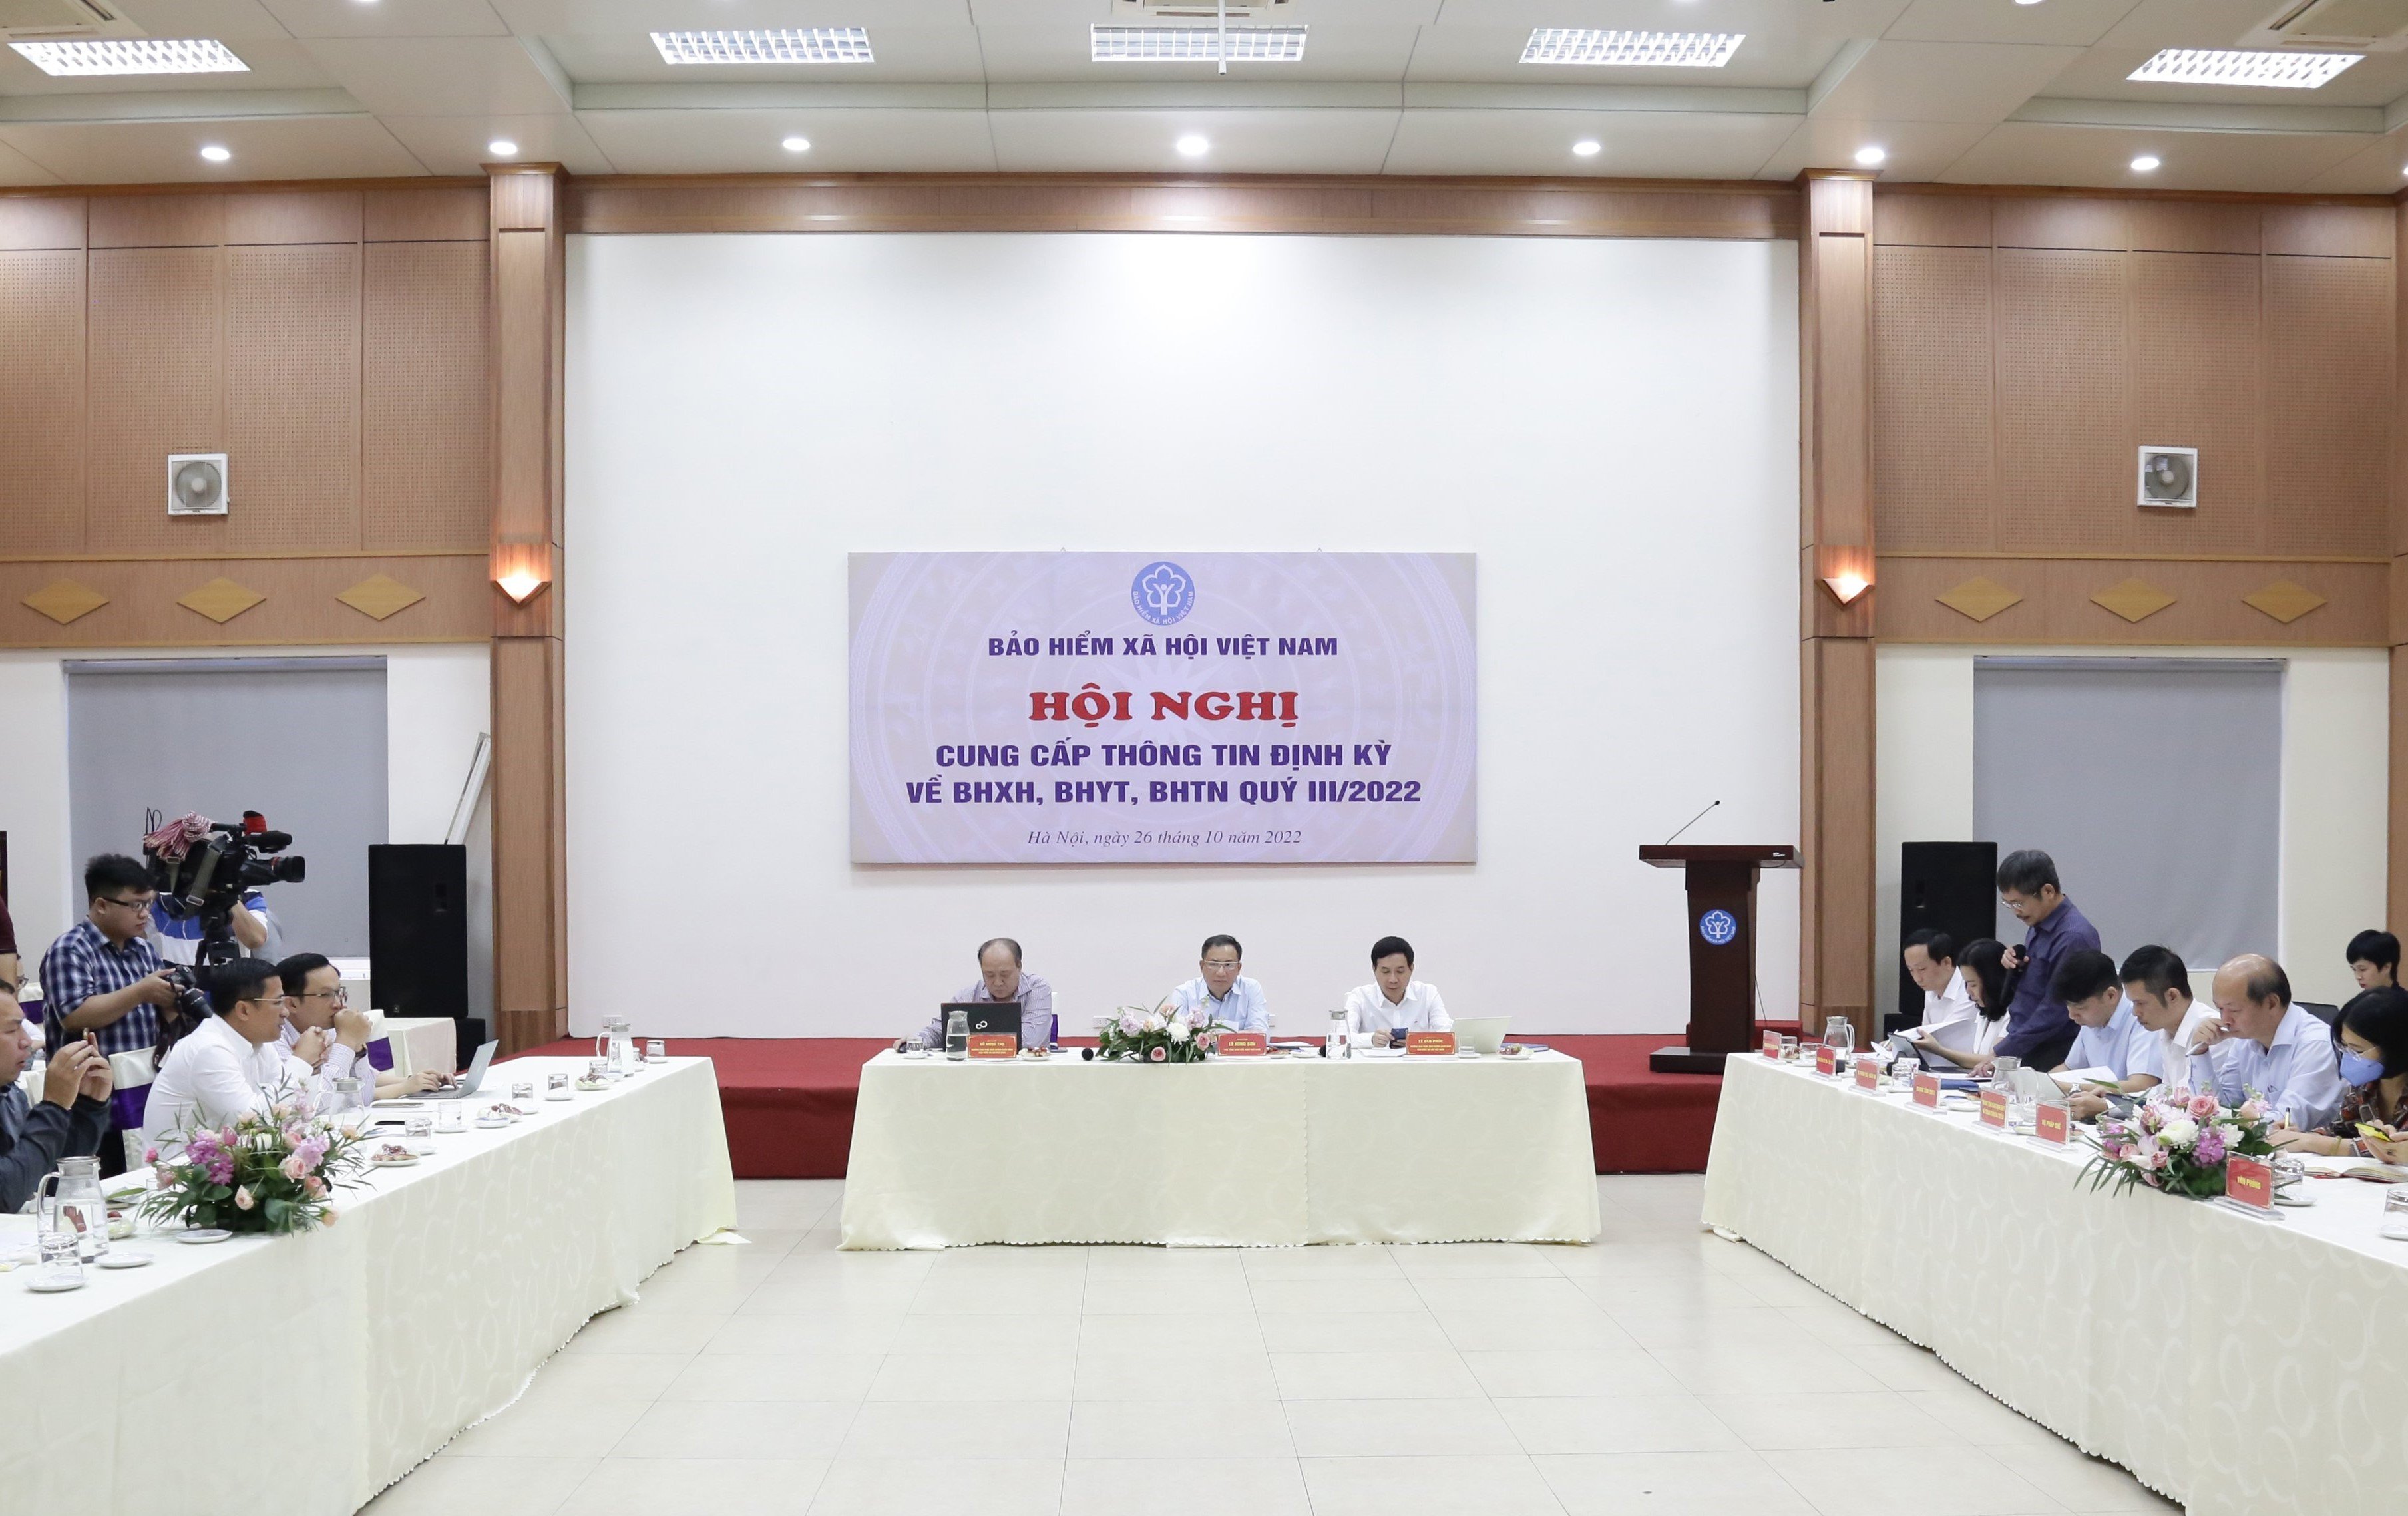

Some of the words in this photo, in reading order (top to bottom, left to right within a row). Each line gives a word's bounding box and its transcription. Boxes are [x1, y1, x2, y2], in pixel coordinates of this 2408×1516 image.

[988, 630, 1040, 656] BẢO
[1048, 630, 1113, 656] HIỂM
[1122, 634, 1157, 656] XÃ
[1165, 633, 1207, 659] HỘI
[1216, 633, 1271, 659] VIỆT
[1279, 637, 1338, 656] NAM
[1028, 682, 1133, 729] HỘI
[1149, 691, 1299, 728] NGHỊ
[936, 744, 1020, 767] CUNG
[1030, 737, 1091, 767] CẤP
[1100, 739, 1201, 767] THÔNG
[1211, 744, 1260, 766] TIN
[1269, 744, 1343, 771] ĐỊNH
[1354, 739, 1392, 766] KỲ
[906, 773, 942, 803] VỀ
[953, 781, 1044, 806] BHXH,
[1054, 781, 1139, 805] BHYT,
[1149, 781, 1229, 803] BHTN
[1239, 776, 1298, 805] QUÝ
[1308, 780, 1421, 803] III/2022
[1027, 831, 1051, 844] Hà
[1056, 831, 1089, 847] Nội,
[1094, 831, 1130, 847] ngày
[1133, 830, 1153, 844] 26
[1157, 830, 1200, 847] tháng
[1205, 830, 1223, 844] 10
[1228, 831, 1260, 844] năm
[1264, 830, 1302, 844] 2022
